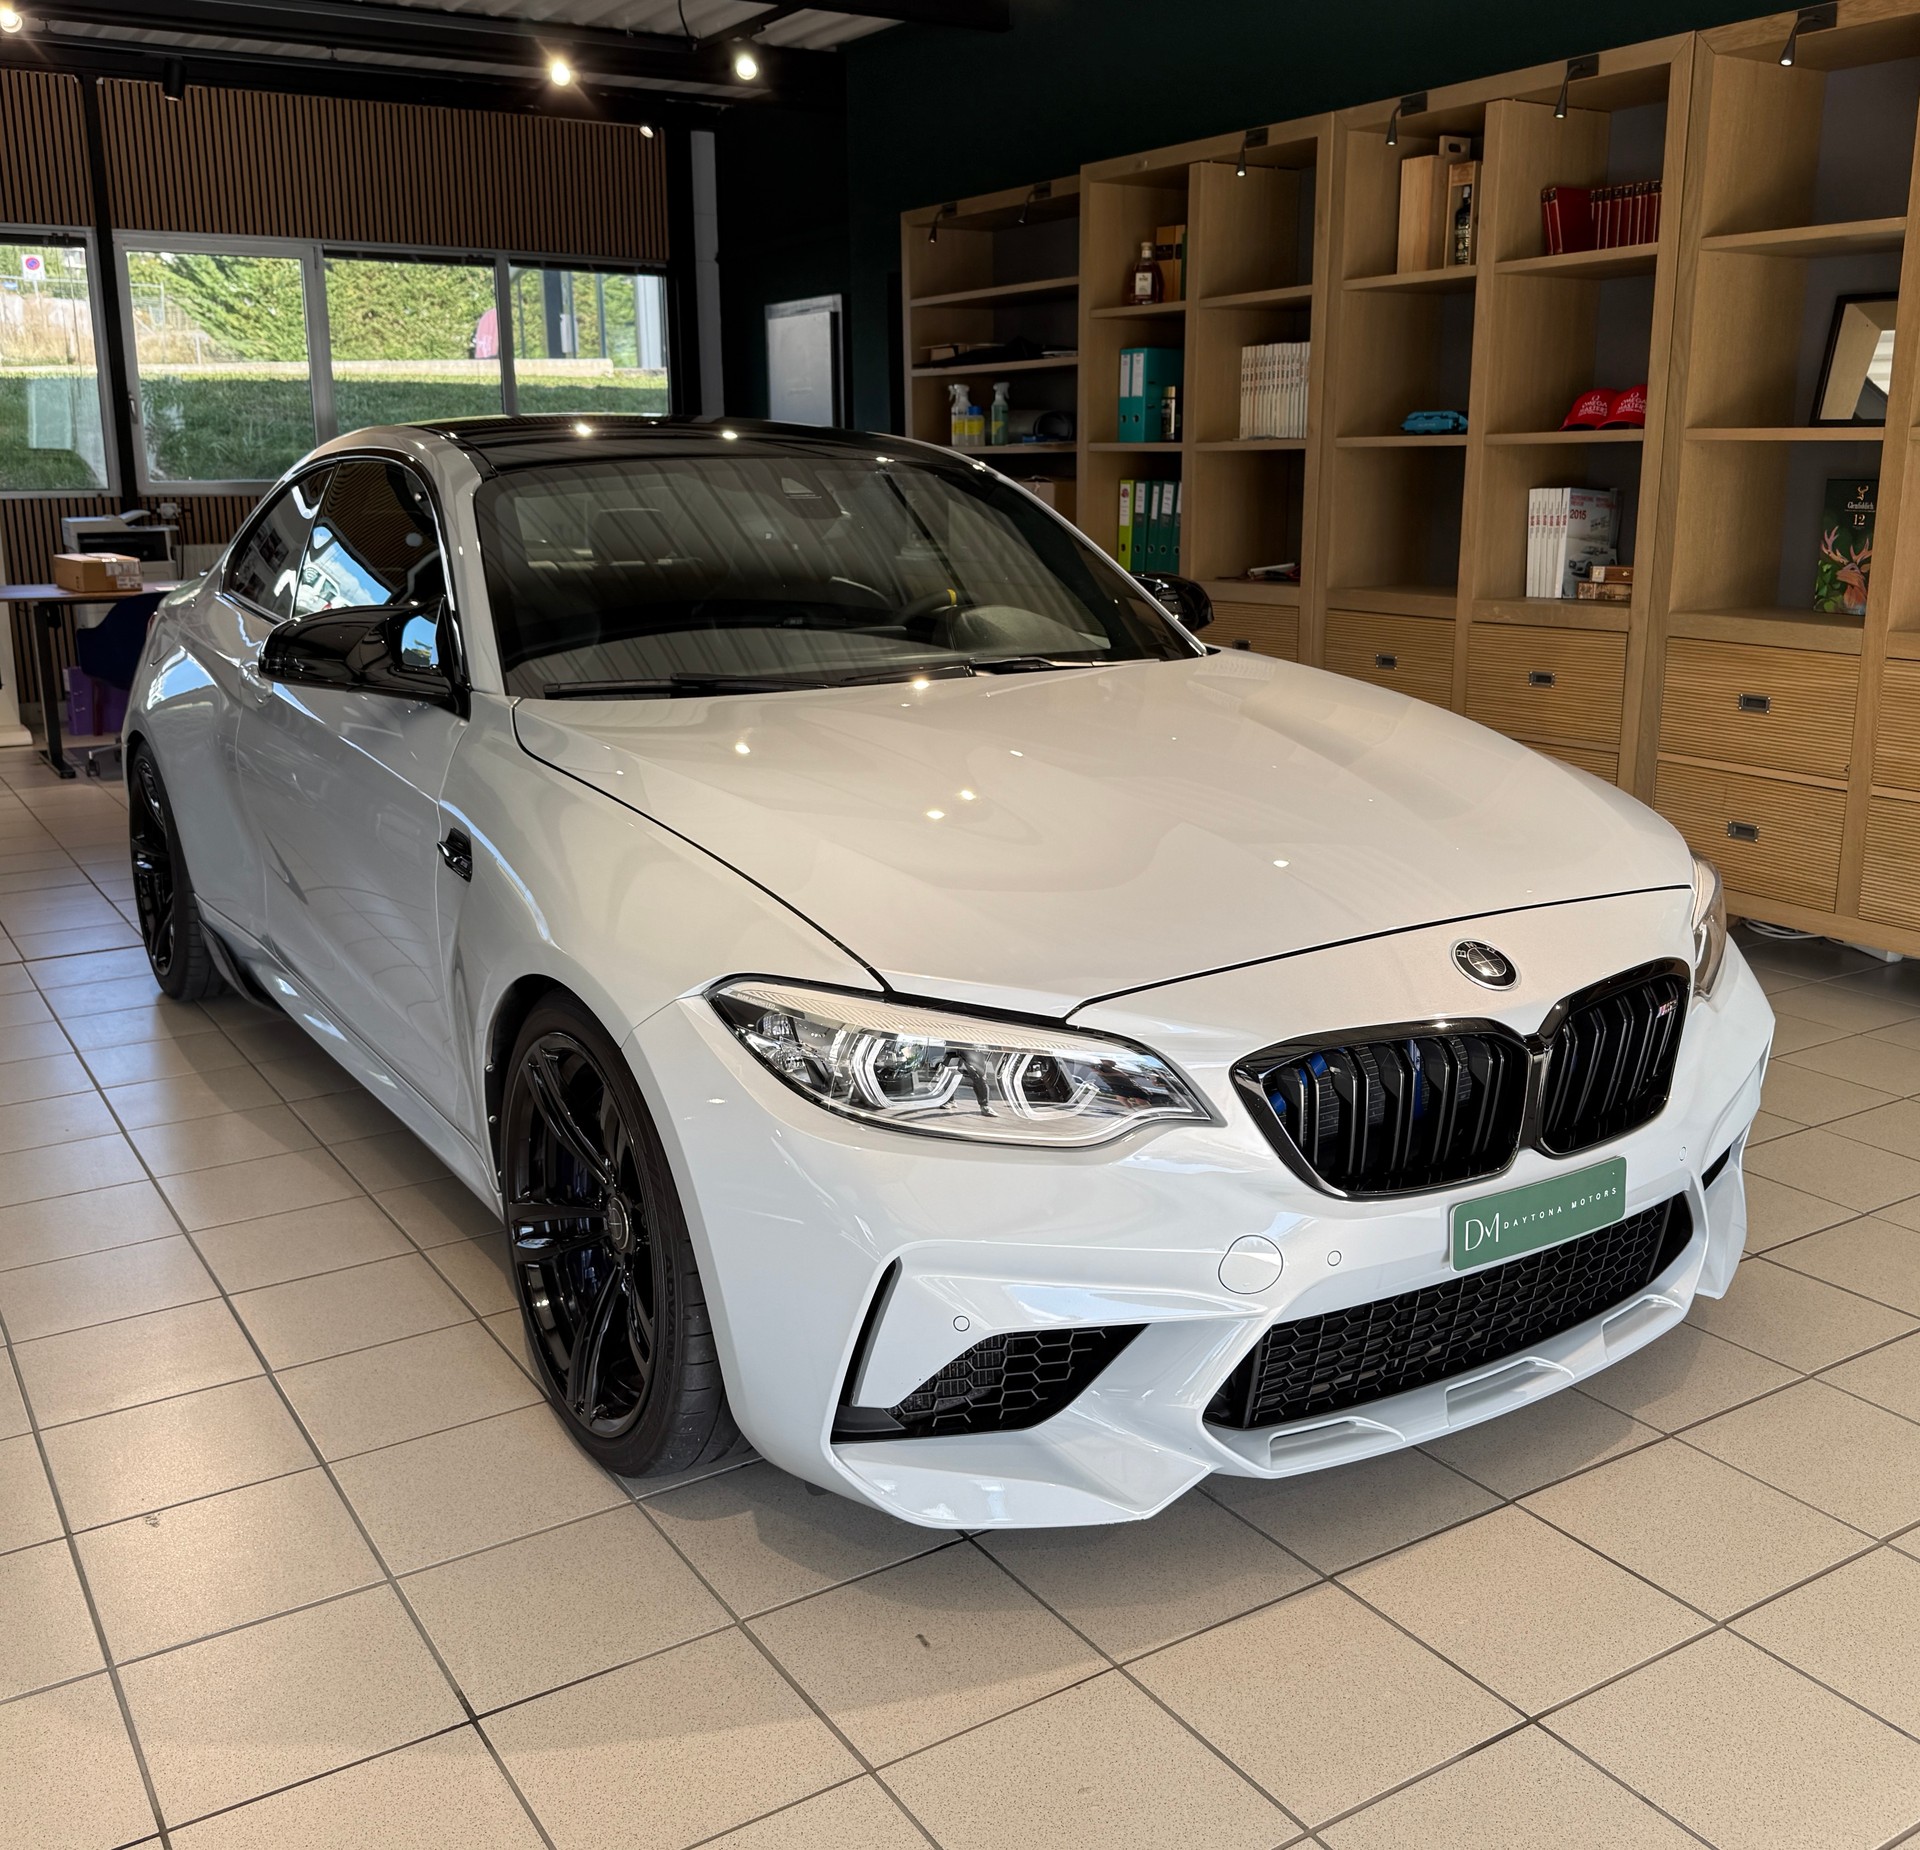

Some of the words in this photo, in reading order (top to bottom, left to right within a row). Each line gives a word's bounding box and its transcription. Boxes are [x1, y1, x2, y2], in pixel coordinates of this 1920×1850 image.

[1569, 509, 1587, 520] 2015
[1853, 514, 1866, 526] 12
[1503, 1206, 1563, 1230] DAYTONA
[1571, 1187, 1617, 1210] MOTORS
[663, 1254, 678, 1362] ADVAN
